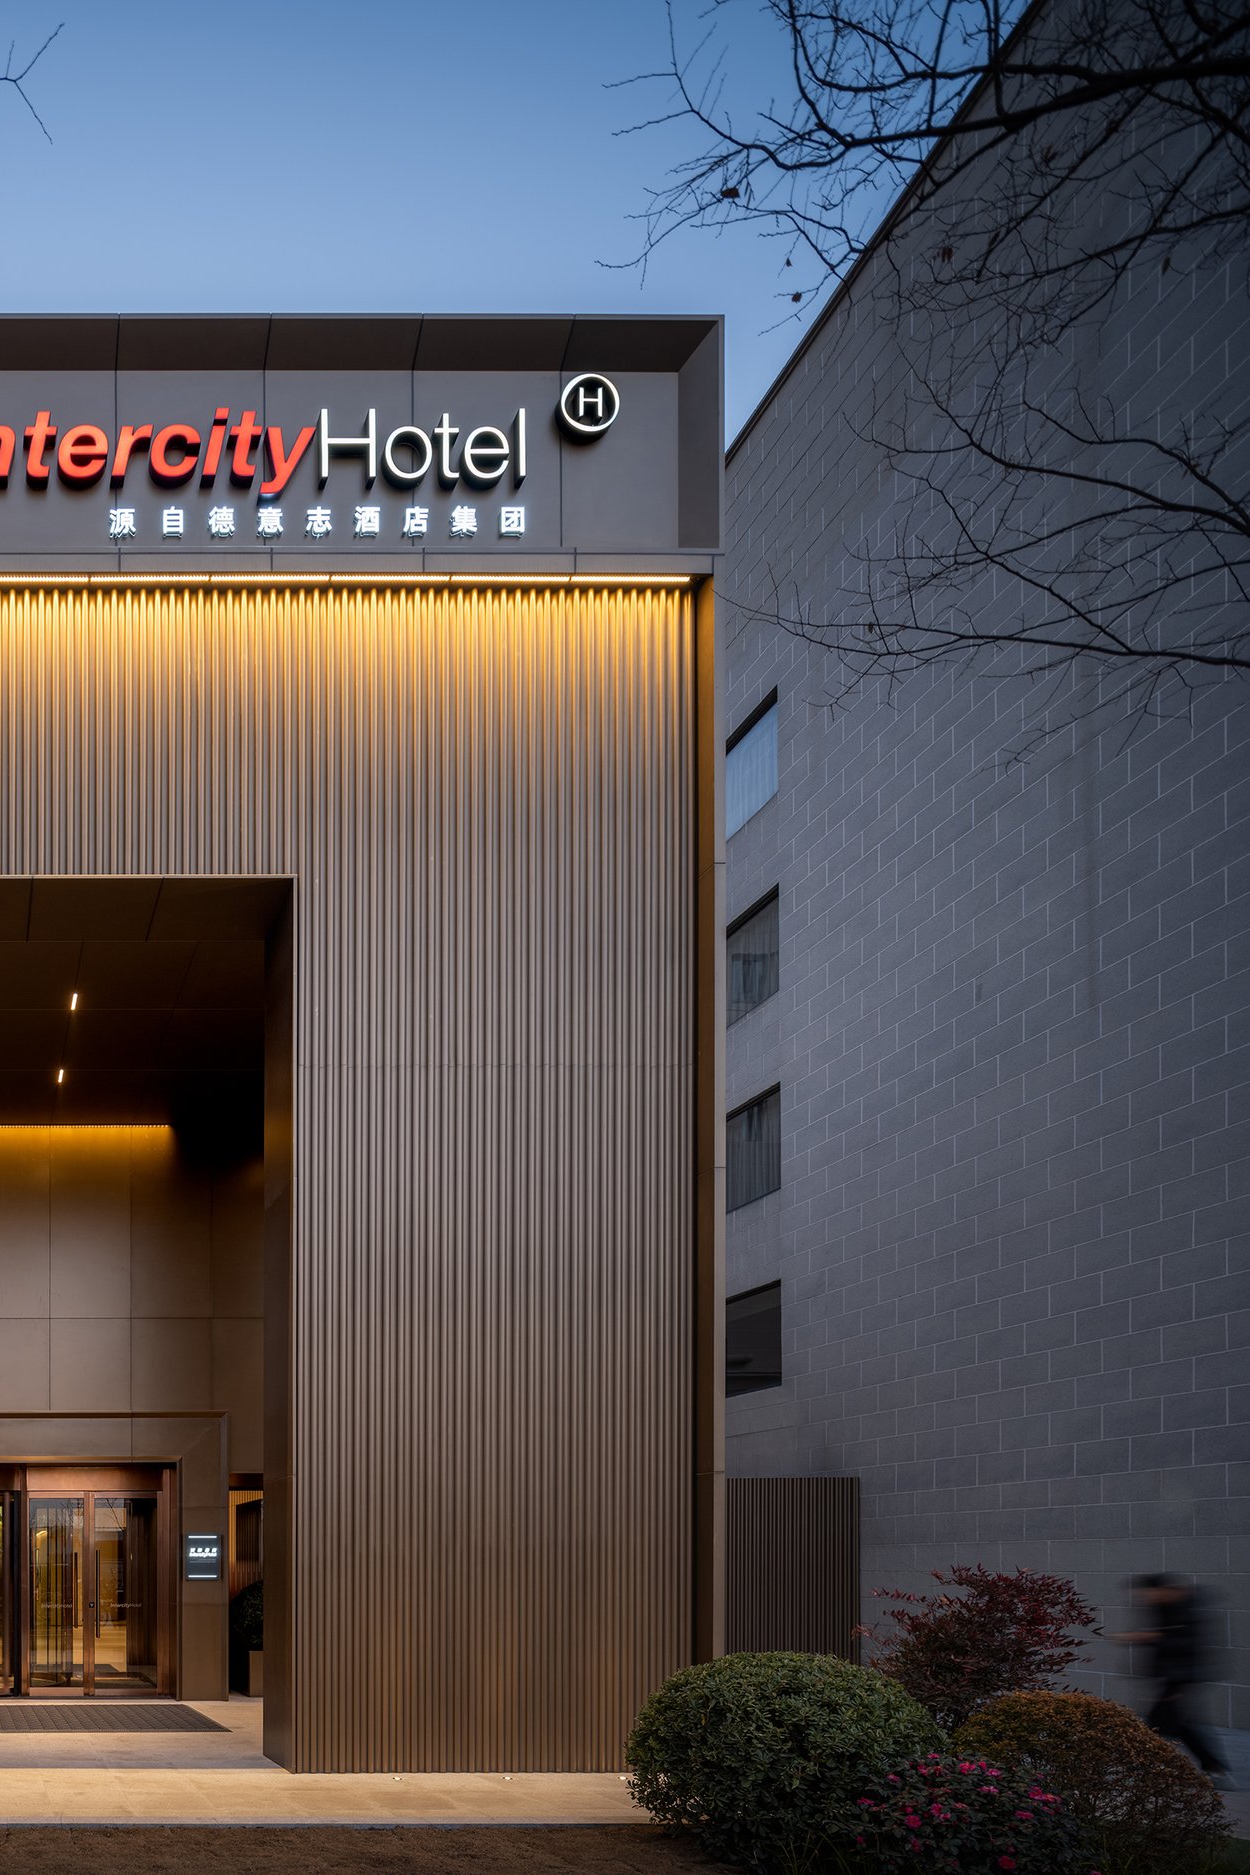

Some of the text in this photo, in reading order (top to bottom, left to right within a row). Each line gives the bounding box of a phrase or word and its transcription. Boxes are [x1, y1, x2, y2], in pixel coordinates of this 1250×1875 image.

[109, 505, 526, 535] 源自德意志酒店集团
